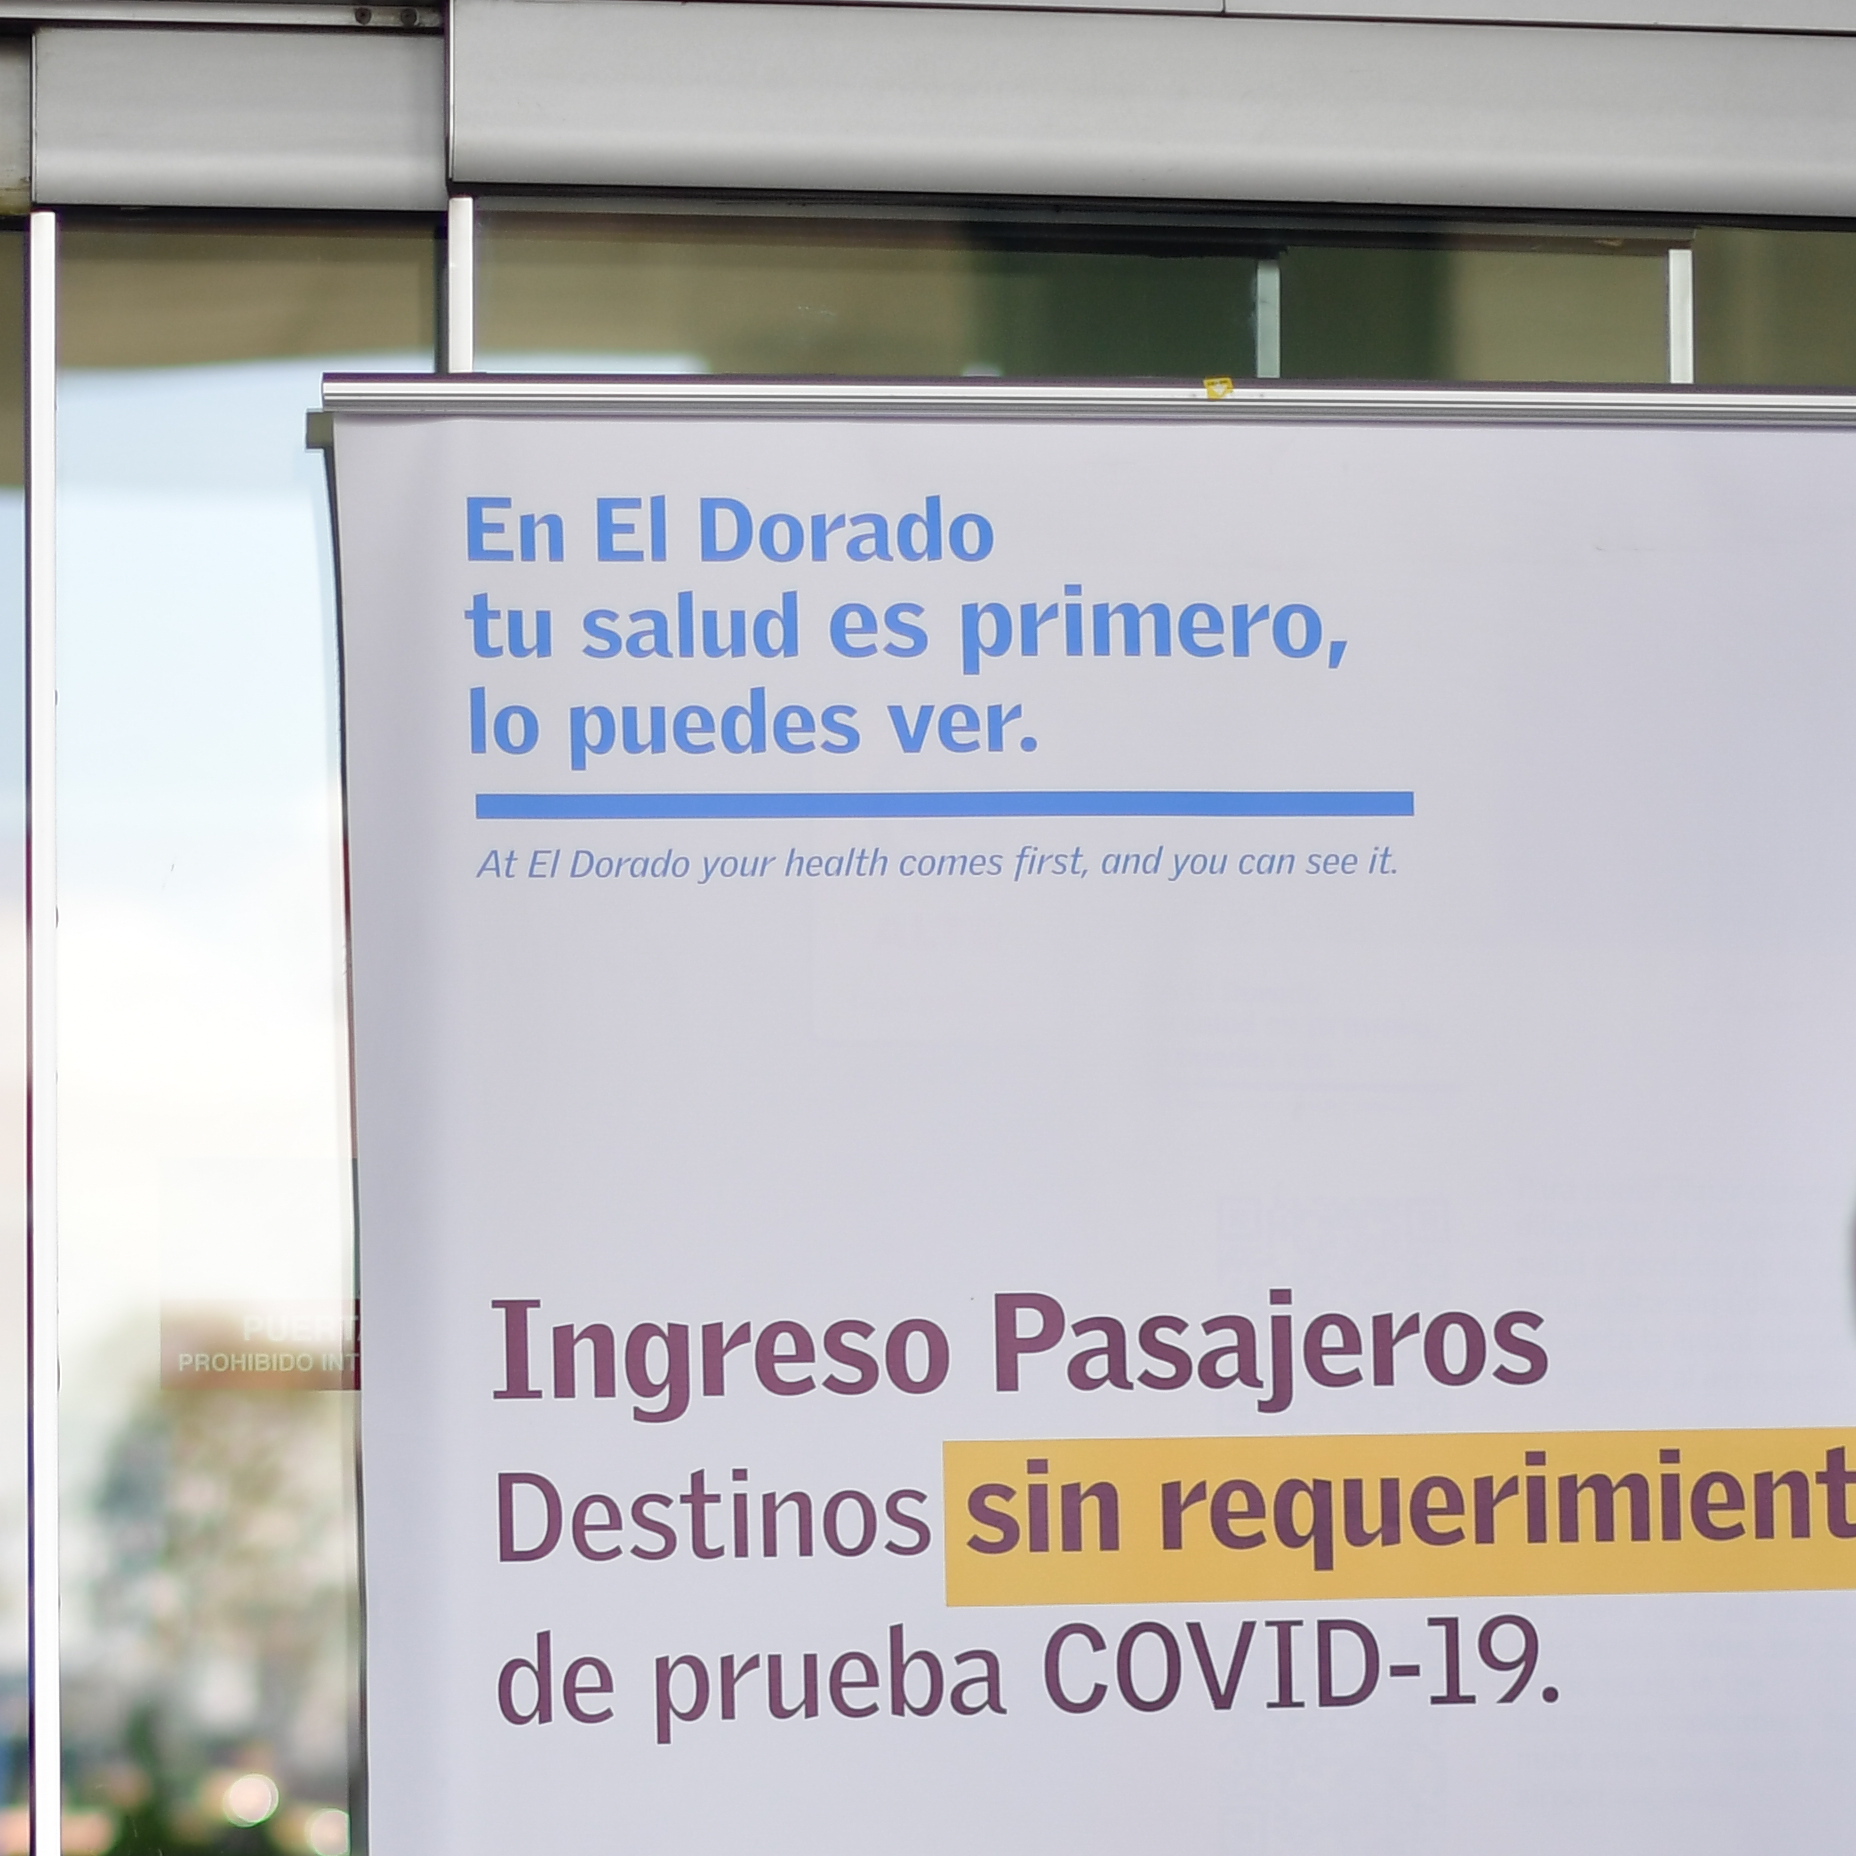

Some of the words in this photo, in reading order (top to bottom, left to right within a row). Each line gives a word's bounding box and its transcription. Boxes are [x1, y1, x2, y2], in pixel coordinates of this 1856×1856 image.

[466, 496, 564, 562] En
[596, 494, 667, 562] El
[700, 494, 994, 563] Dorado
[464, 592, 552, 658] tu
[582, 590, 799, 659] salud
[829, 602, 928, 658] es
[961, 583, 1347, 675] primero,
[470, 686, 539, 755] lo
[569, 686, 861, 771] puedes
[887, 703, 1038, 754] ver.
[476, 849, 518, 879] At
[528, 848, 561, 878] El
[570, 848, 690, 878] Dorado
[697, 856, 777, 885] your
[785, 847, 888, 877] health
[899, 854, 1004, 877] comes
[1014, 845, 1088, 882] first,
[1101, 845, 1164, 875] and
[1168, 853, 1228, 882] you
[1238, 854, 1296, 875] can
[1305, 853, 1358, 875] see
[1368, 846, 1398, 875] it.
[178, 1353, 312, 1372] PROHIBIDO
[491, 1299, 950, 1424] Ingreso
[994, 1288, 1548, 1414] Pasajeros
[498, 1468, 931, 1563] Destinos
[965, 1458, 1120, 1555] sin
[498, 1630, 614, 1726] de
[655, 1623, 1008, 1745] prueba
[1044, 1614, 1559, 1714] COVID-19.
